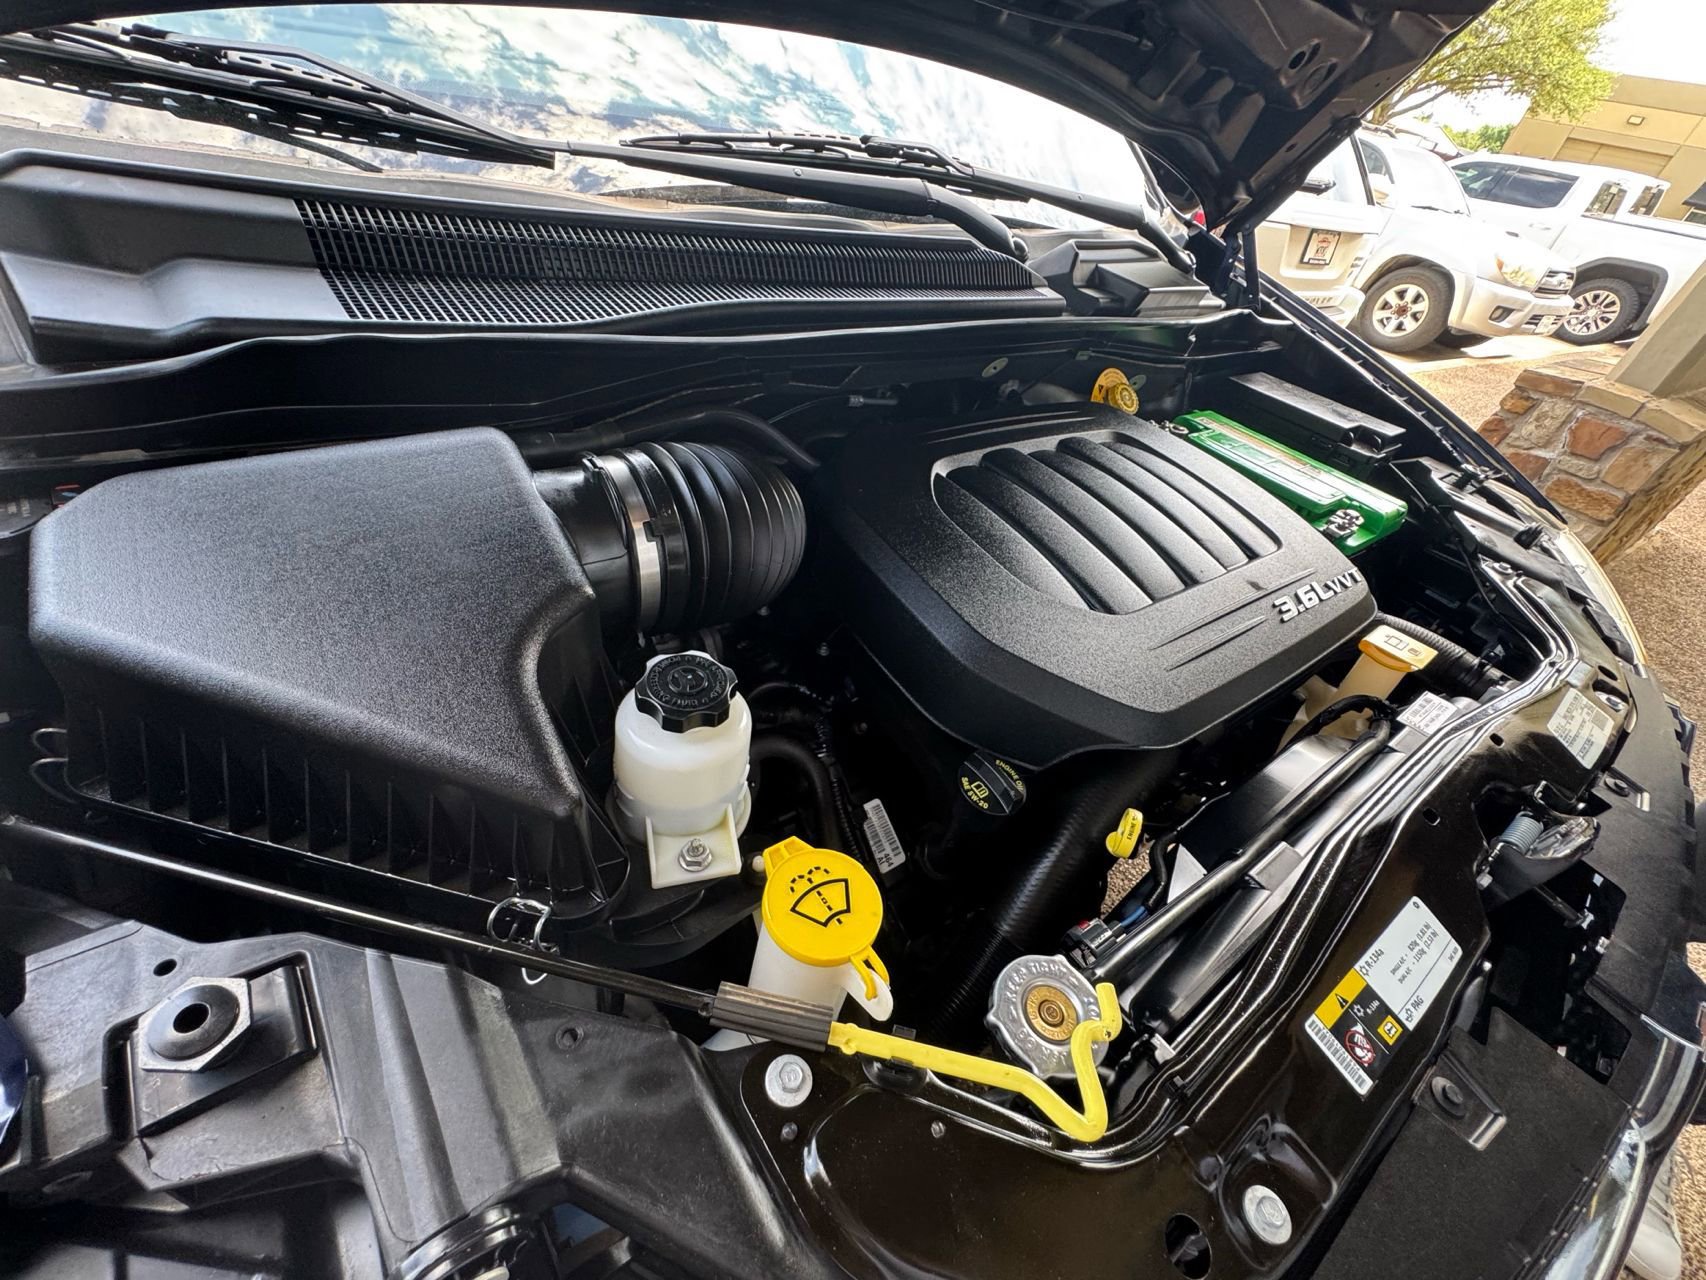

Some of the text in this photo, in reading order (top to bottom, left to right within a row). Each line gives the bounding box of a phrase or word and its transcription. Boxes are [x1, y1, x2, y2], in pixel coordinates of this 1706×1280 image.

[1273, 567, 1362, 622] 3.6L VVT
[995, 759, 1019, 783] ENGINE
[961, 776, 989, 810] SAE 5W-20
[1365, 948, 1385, 970] R-134a
[1411, 995, 1425, 1012] PAG
